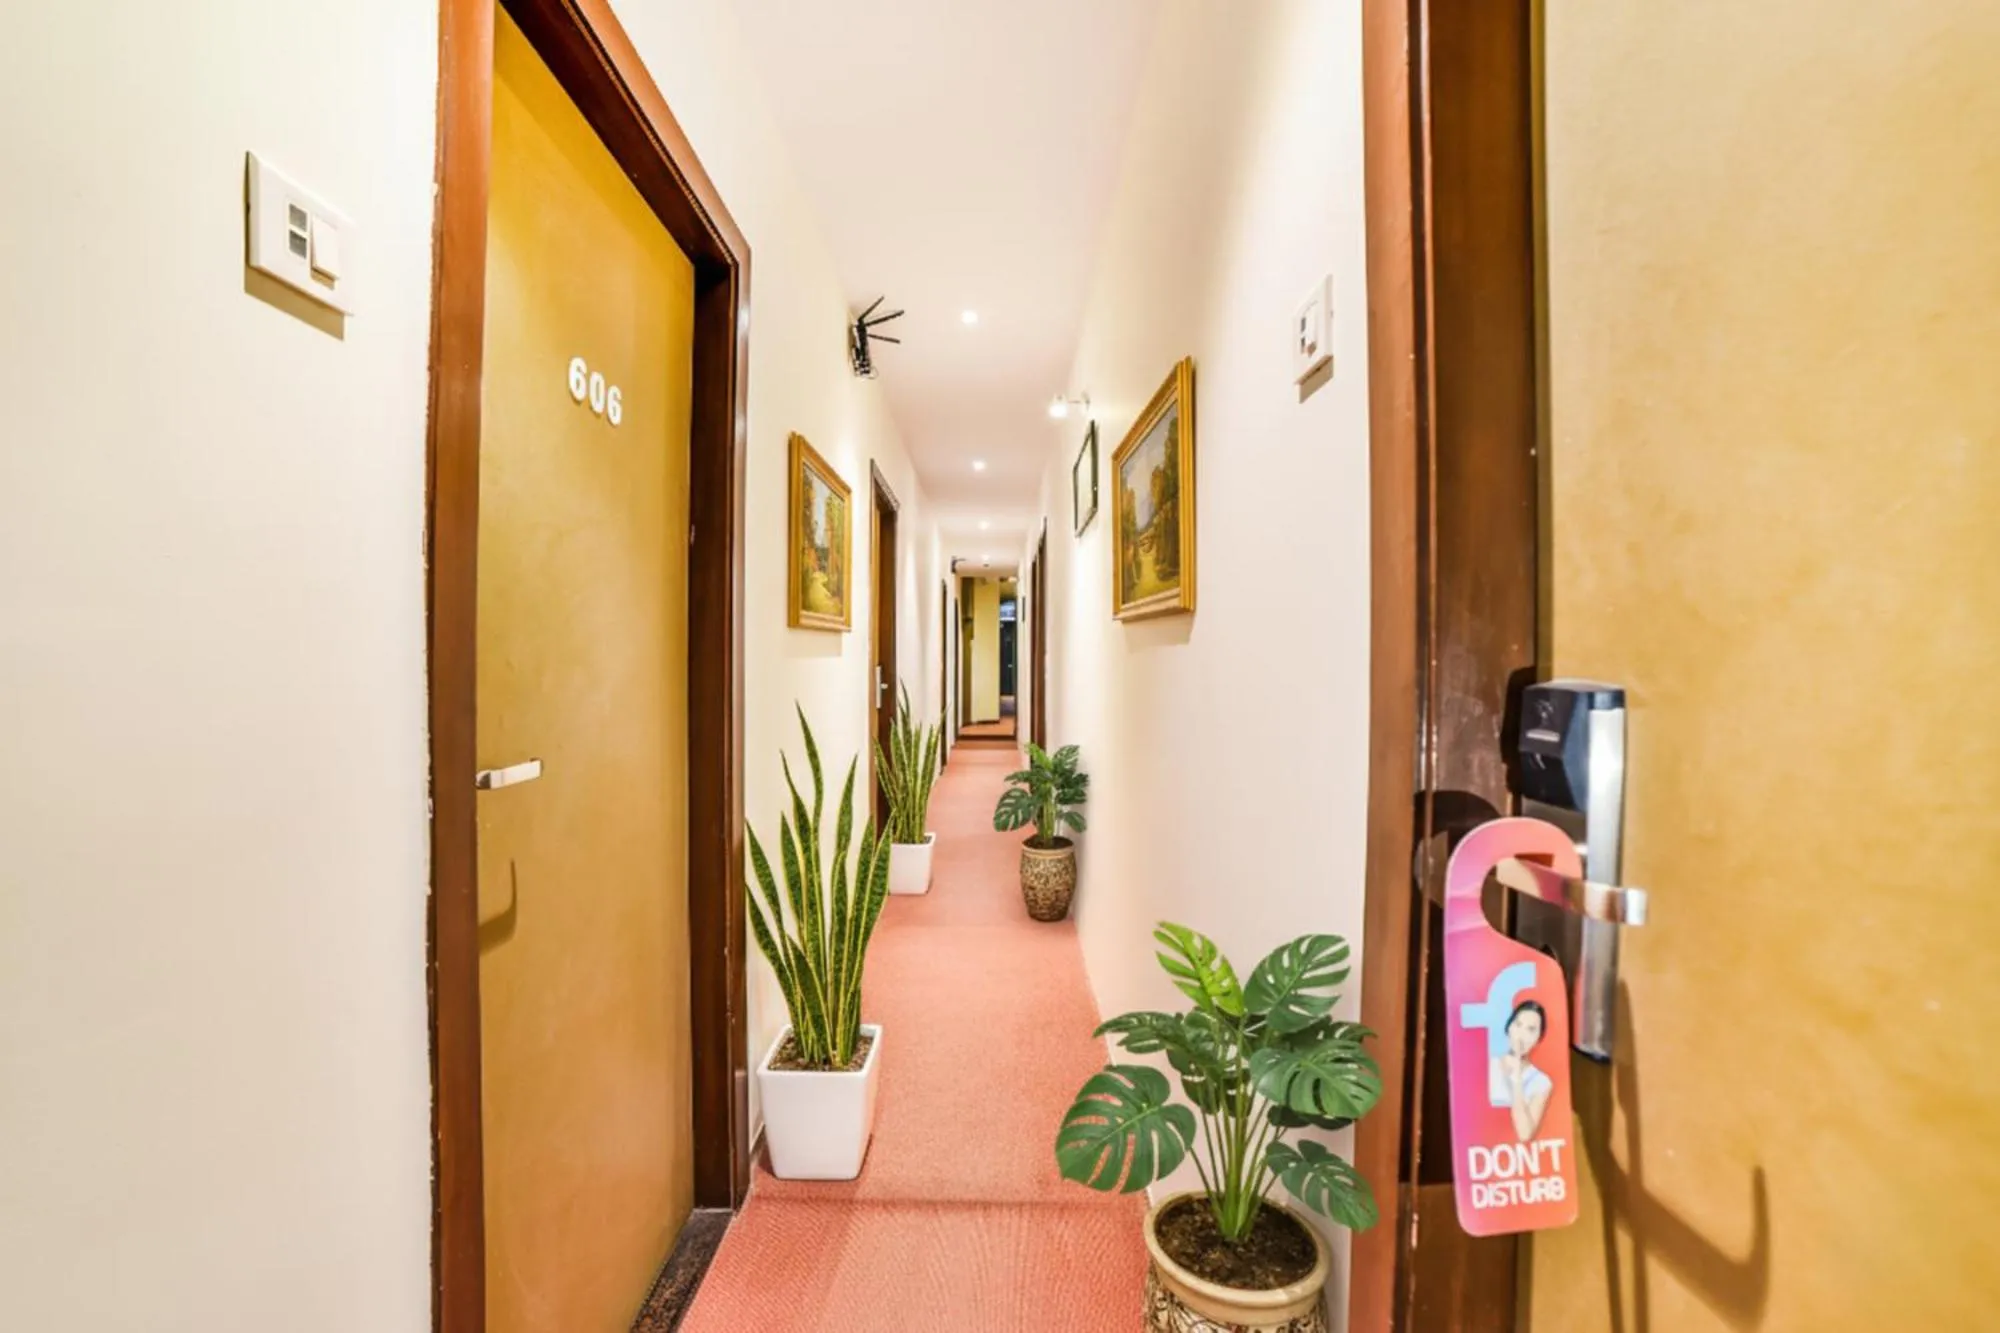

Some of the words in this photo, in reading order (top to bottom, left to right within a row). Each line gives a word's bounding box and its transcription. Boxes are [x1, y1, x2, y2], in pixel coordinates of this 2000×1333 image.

[568, 356, 622, 426] 606
[1460, 961, 1537, 1108] f
[1468, 1138, 1567, 1181] DON'T
[1471, 1175, 1566, 1209] DISTURB
